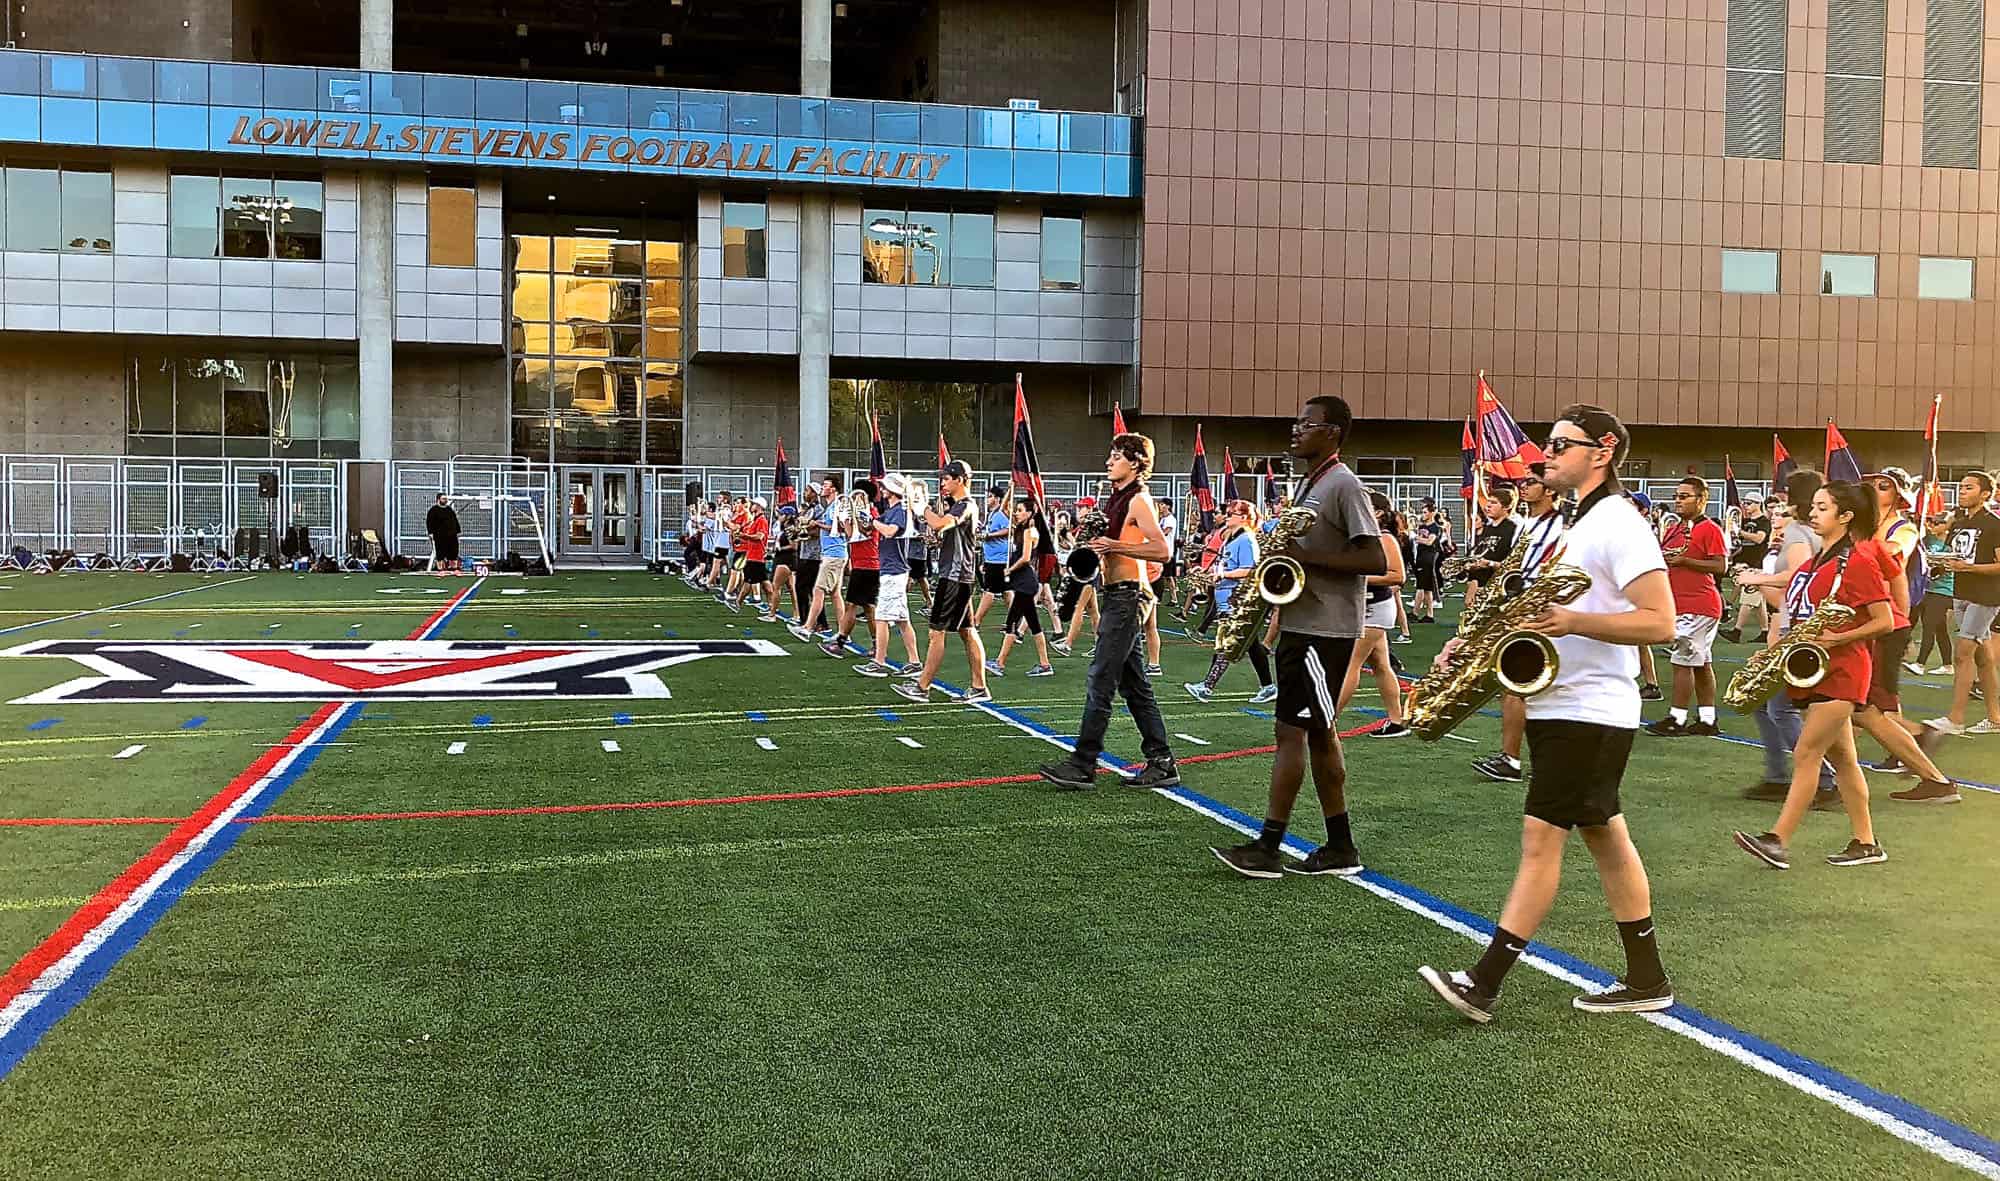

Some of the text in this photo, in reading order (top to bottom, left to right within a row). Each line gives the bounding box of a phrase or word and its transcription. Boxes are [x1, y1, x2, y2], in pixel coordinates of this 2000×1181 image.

[579, 133, 773, 171] FOOTBALL
[785, 146, 951, 180] FACILITY
[475, 566, 489, 577] 50
